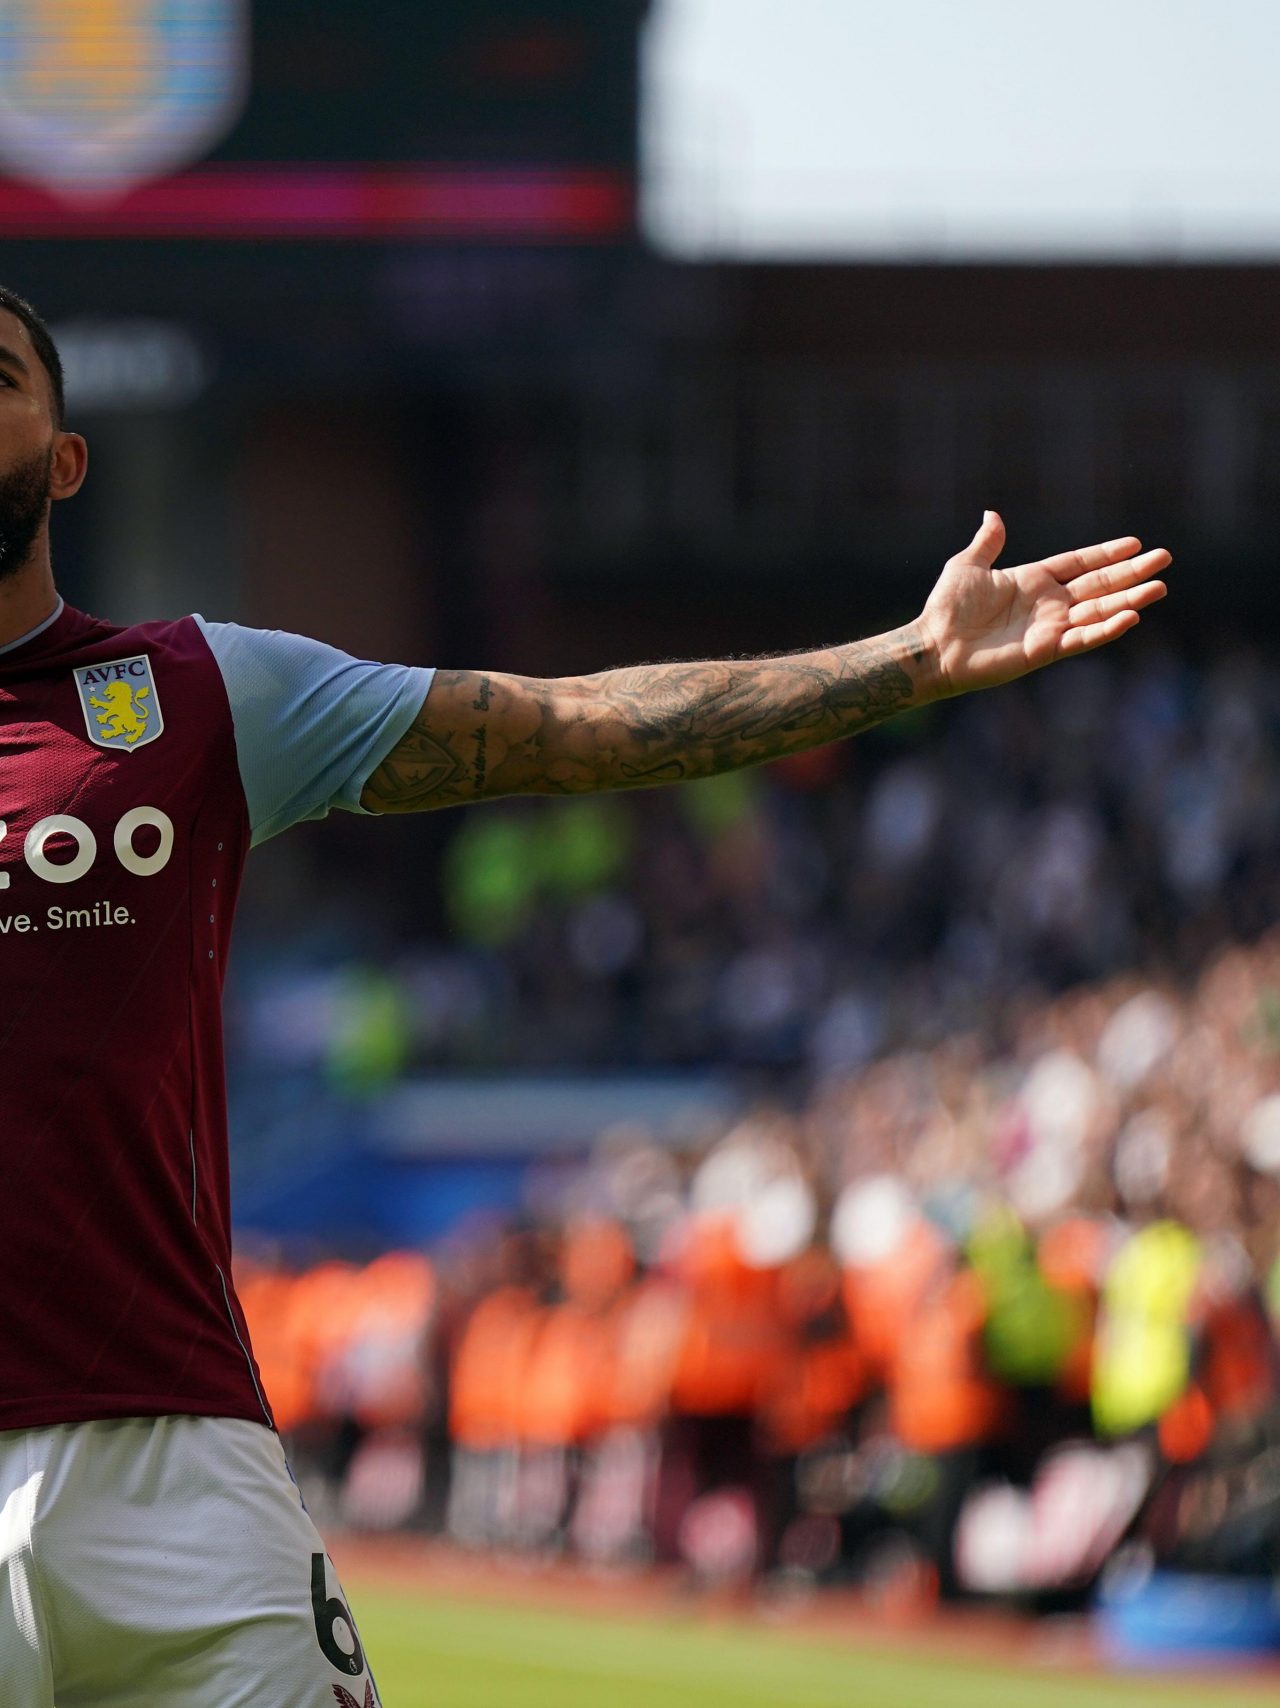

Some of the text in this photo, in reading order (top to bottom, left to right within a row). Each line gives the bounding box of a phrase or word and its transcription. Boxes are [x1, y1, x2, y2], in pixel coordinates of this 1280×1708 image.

[83, 660, 146, 685] AVFC
[46, 900, 136, 931] Smile.
[311, 1552, 364, 1676] 6
